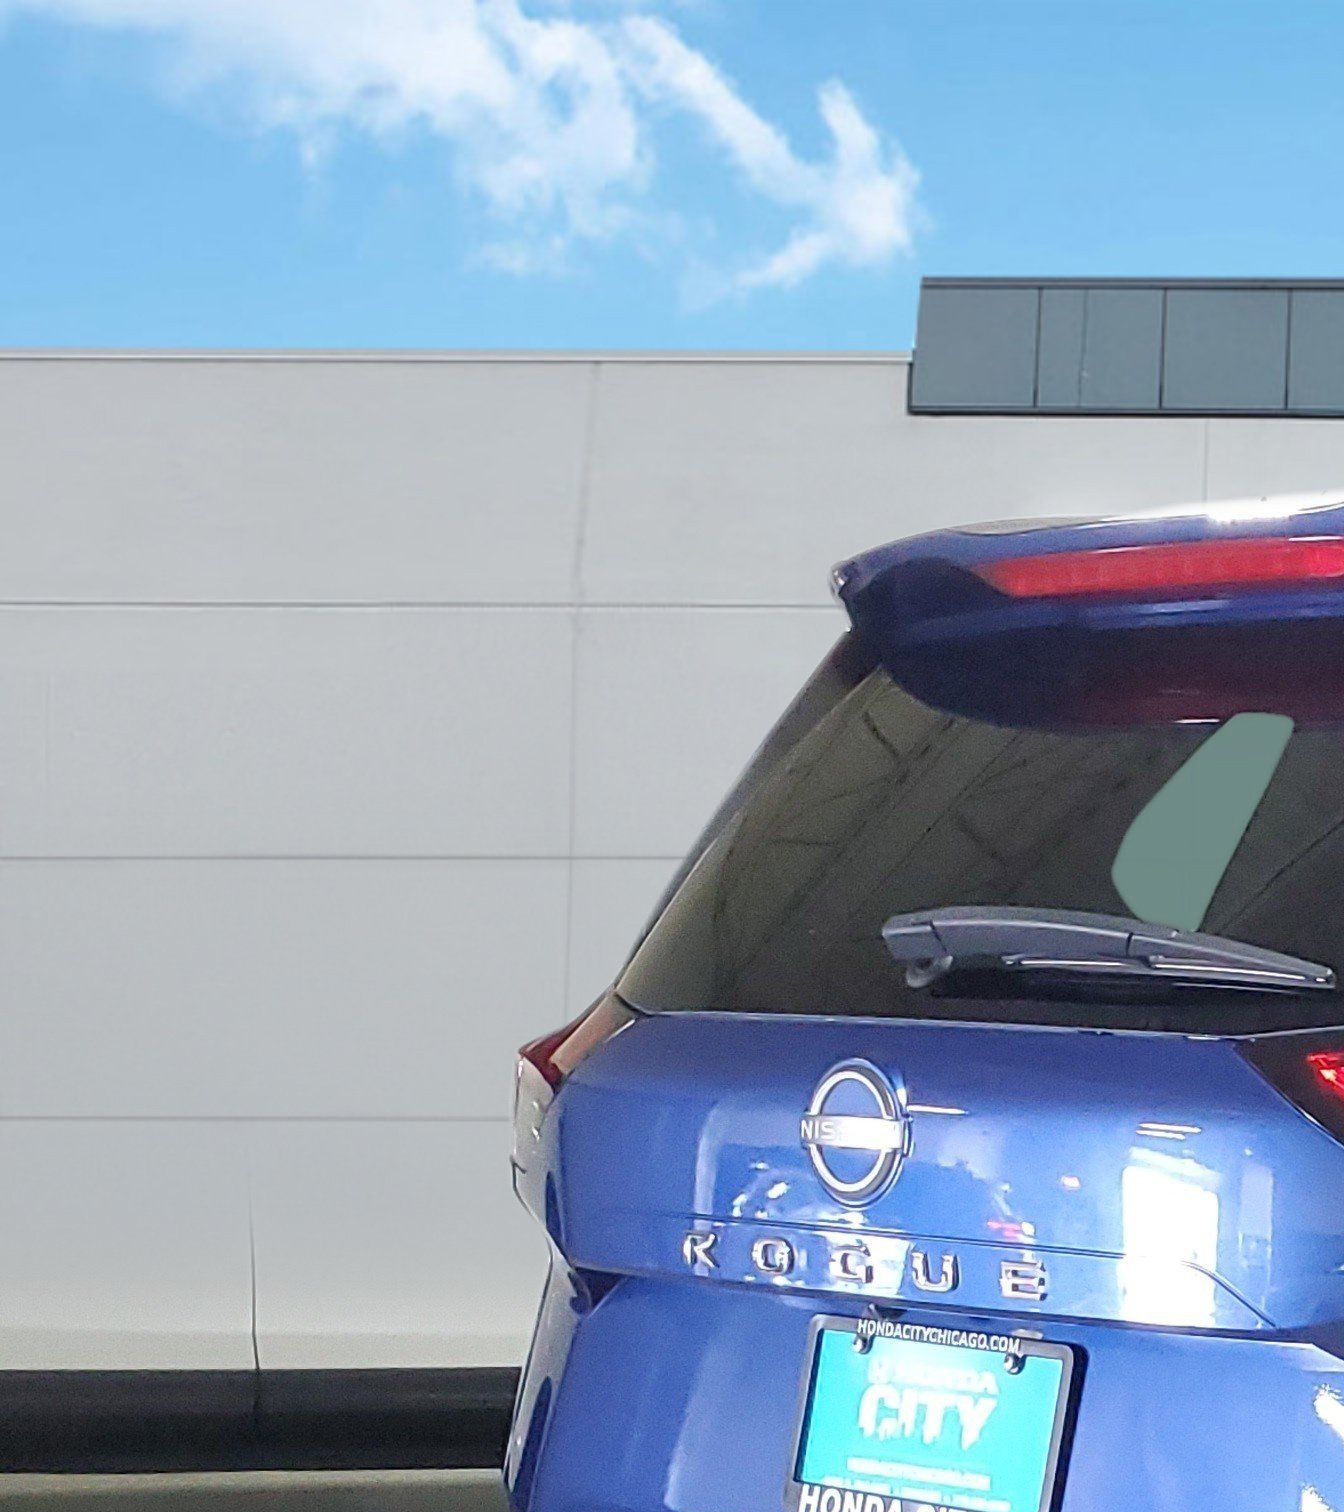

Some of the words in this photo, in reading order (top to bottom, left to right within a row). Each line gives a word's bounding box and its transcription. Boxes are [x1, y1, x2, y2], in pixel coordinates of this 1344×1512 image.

[682, 1231, 1047, 1301] ROGUE
[857, 1318, 1021, 1352] HONDACITYCHICAGO.COM
[858, 1383, 998, 1452] CITY
